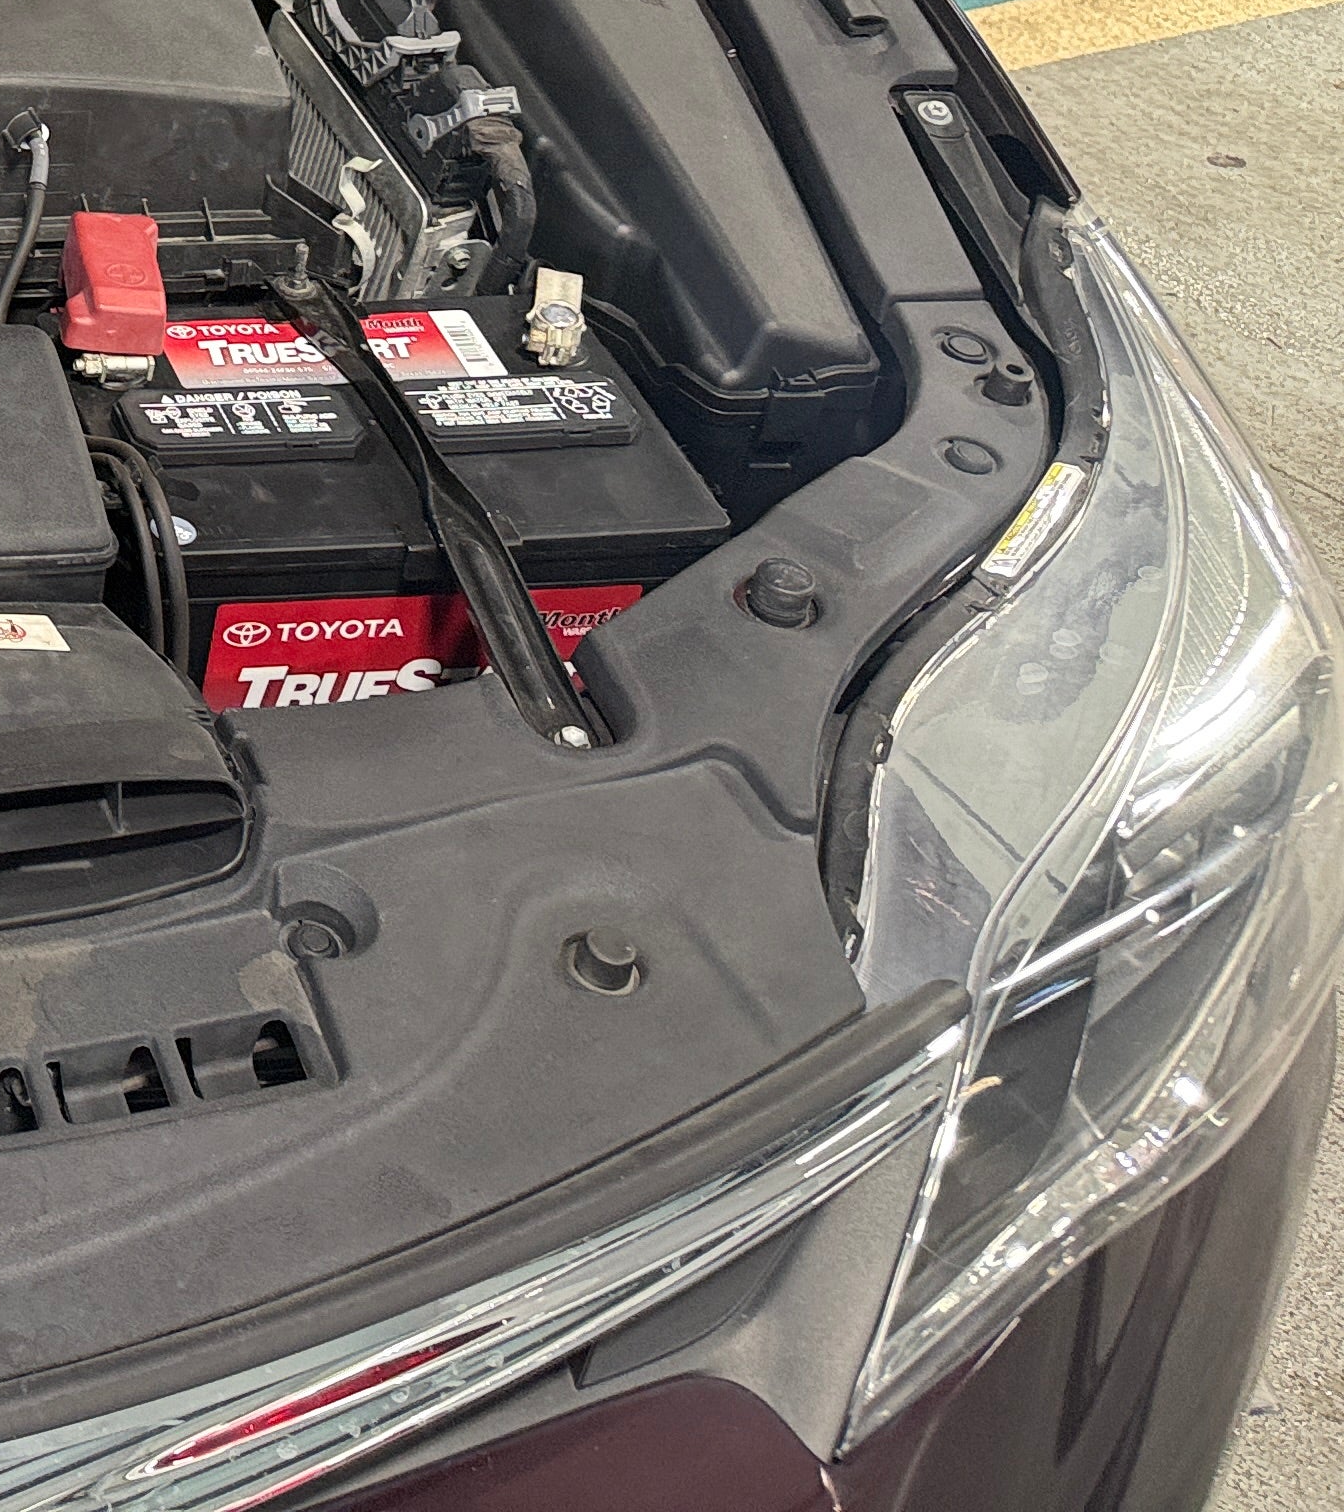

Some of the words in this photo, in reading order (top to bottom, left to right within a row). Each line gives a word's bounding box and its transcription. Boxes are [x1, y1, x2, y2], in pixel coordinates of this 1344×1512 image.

[196, 324, 279, 336] TOYOTA
[176, 392, 234, 404] DANGER
[247, 390, 302, 401] POISON
[277, 618, 404, 643] TOYOTA
